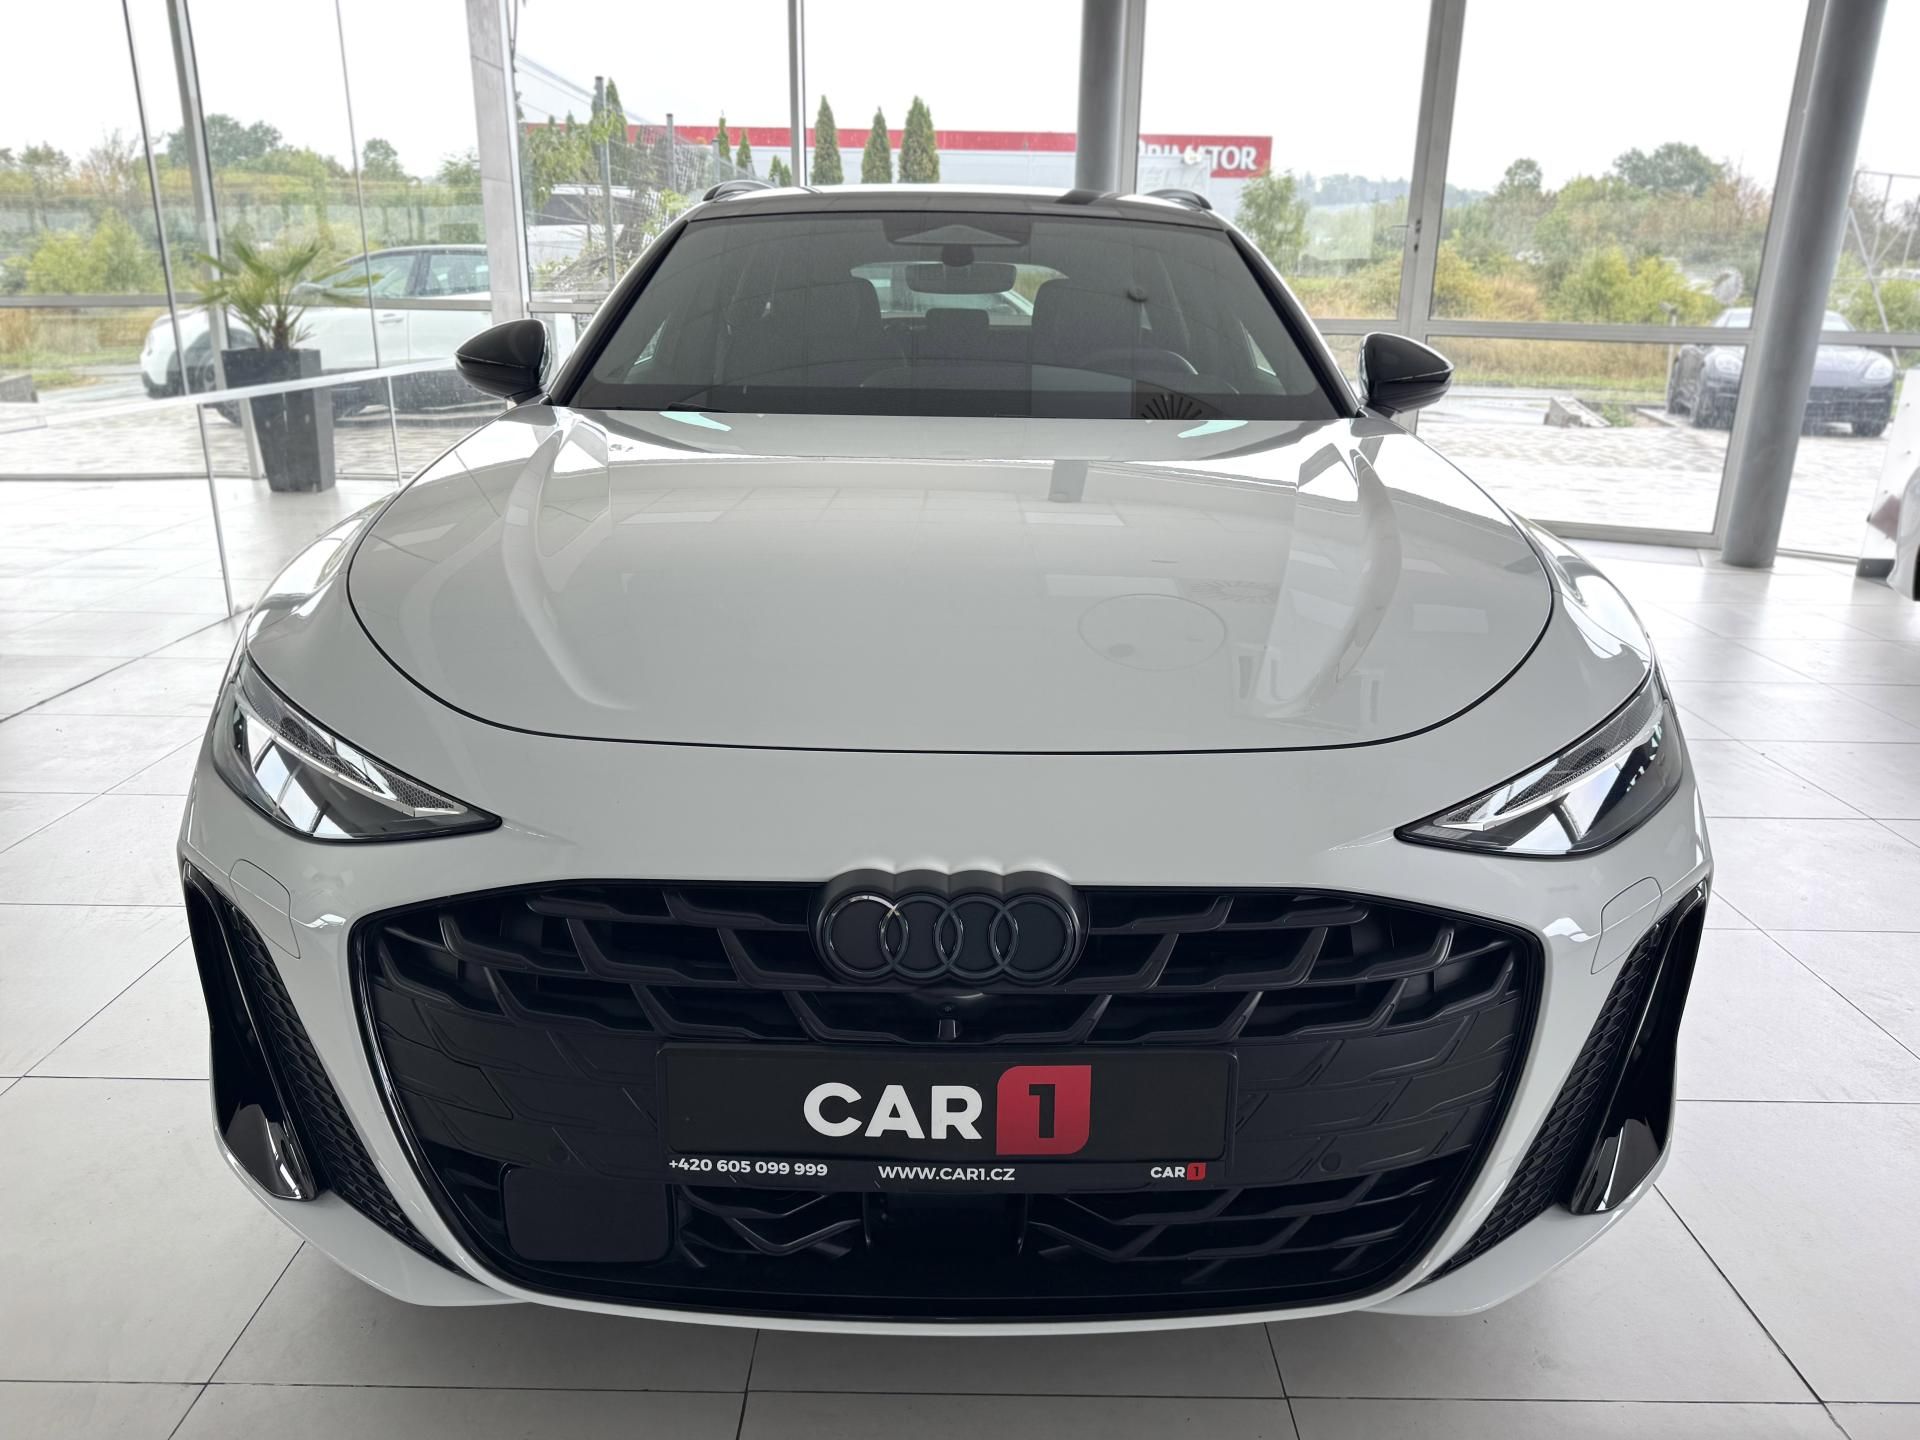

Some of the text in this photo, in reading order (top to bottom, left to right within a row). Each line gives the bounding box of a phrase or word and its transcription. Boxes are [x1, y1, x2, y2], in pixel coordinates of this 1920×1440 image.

[804, 1083, 982, 1139] CAR
[669, 1158, 827, 1176] +420 605 099 999
[878, 1166, 1015, 1180] WWW.CAR1.CZ
[1151, 1167, 1185, 1178] CAR
